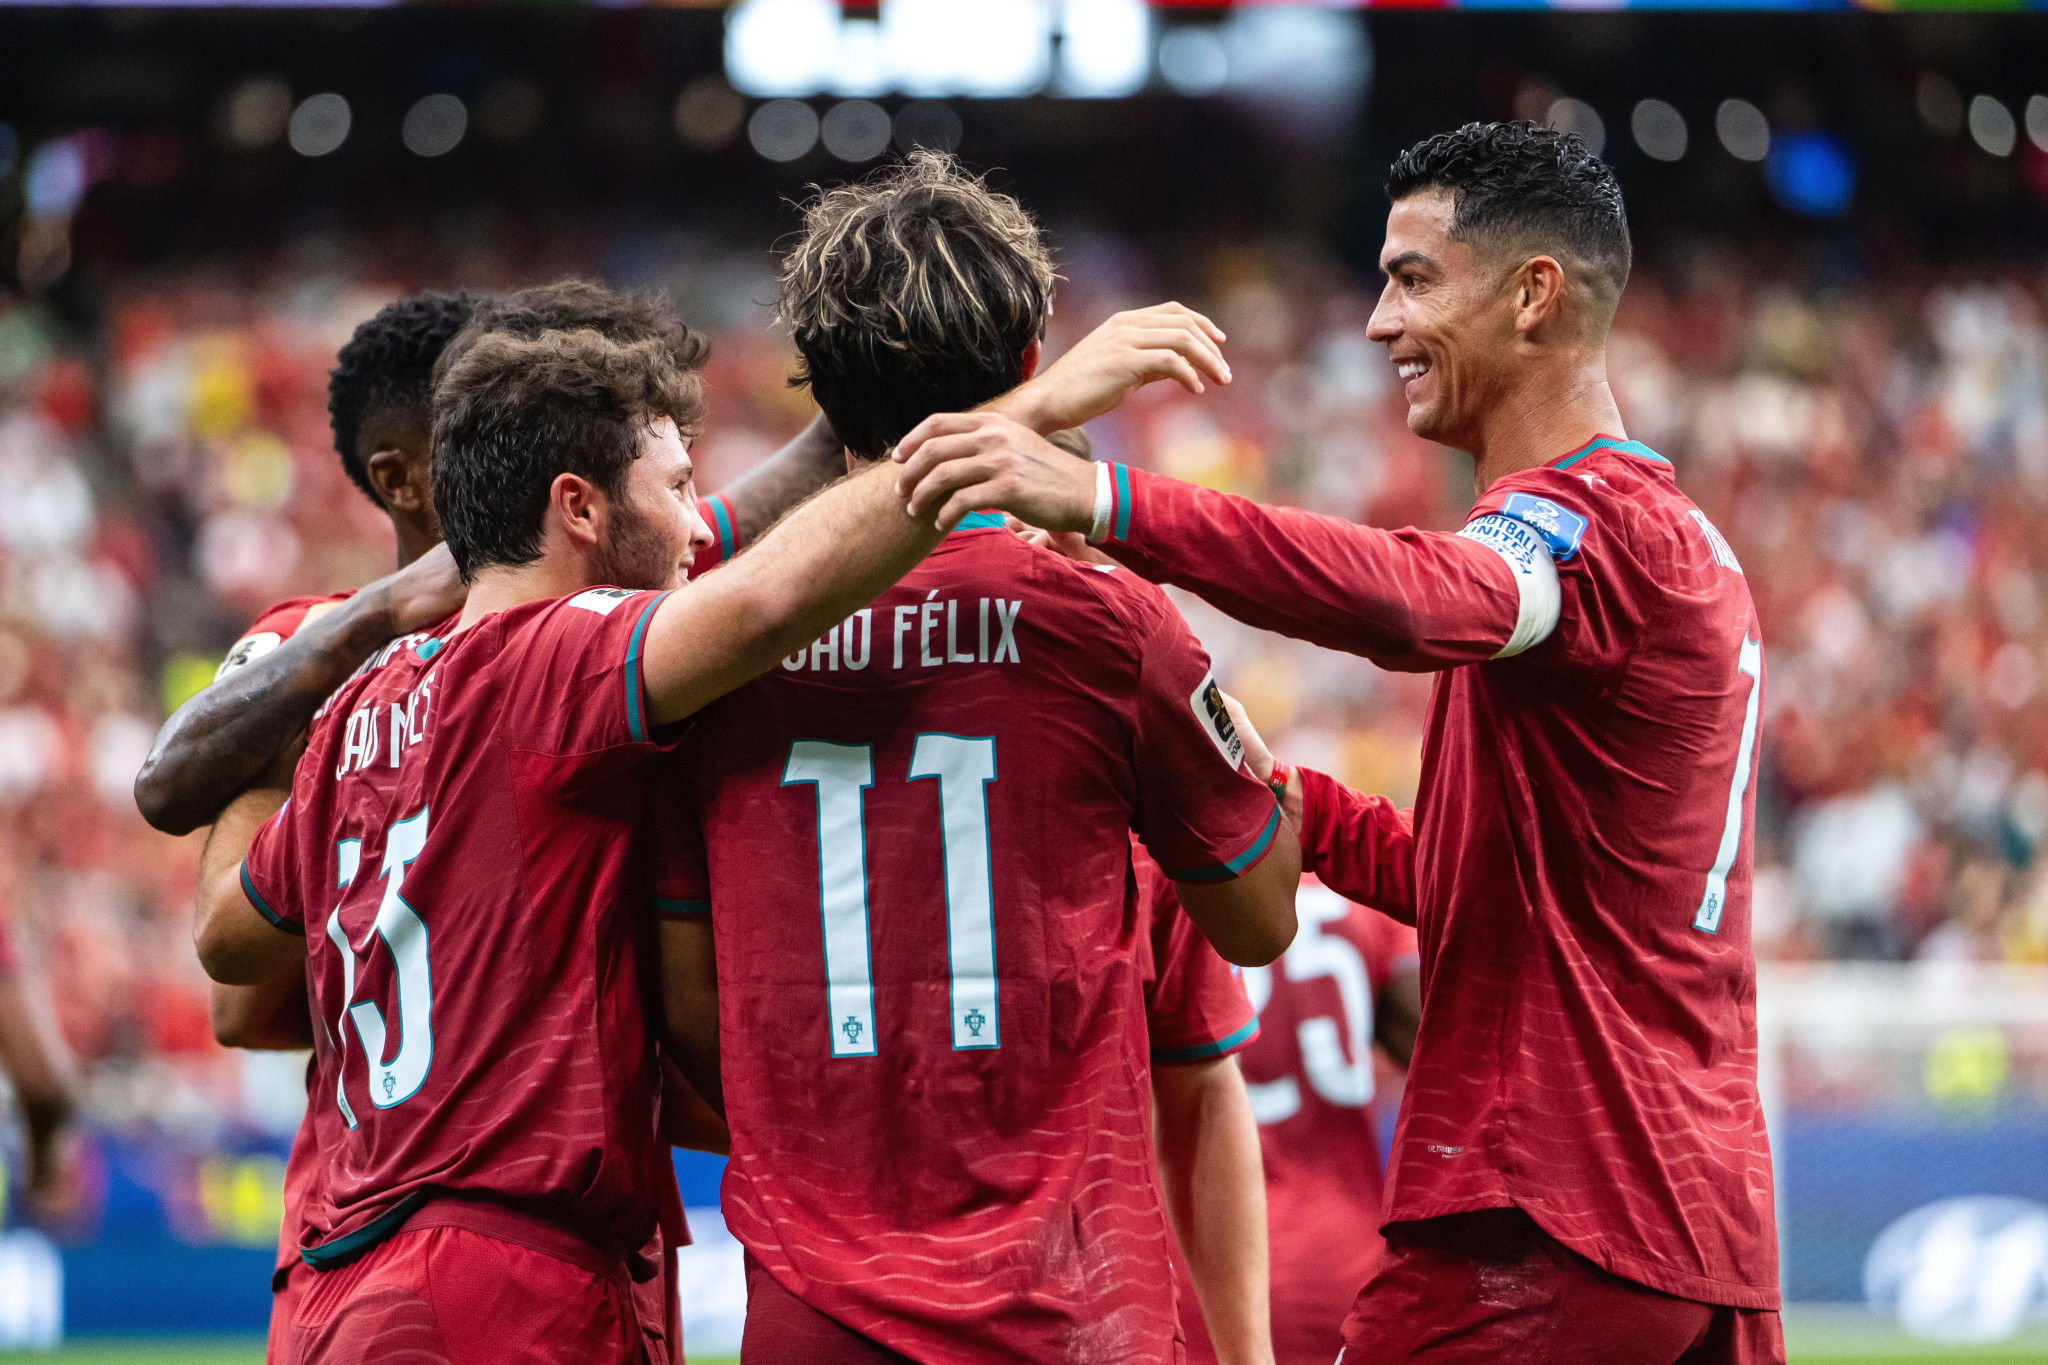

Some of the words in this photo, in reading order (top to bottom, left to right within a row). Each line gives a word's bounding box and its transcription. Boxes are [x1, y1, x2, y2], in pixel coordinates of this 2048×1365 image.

[1472, 515, 1538, 558] OOTBALL
[893, 589, 1022, 670] FÉLIX
[1230, 740, 1242, 761] 202
[780, 731, 1000, 1058] 11
[326, 803, 434, 1132] 13
